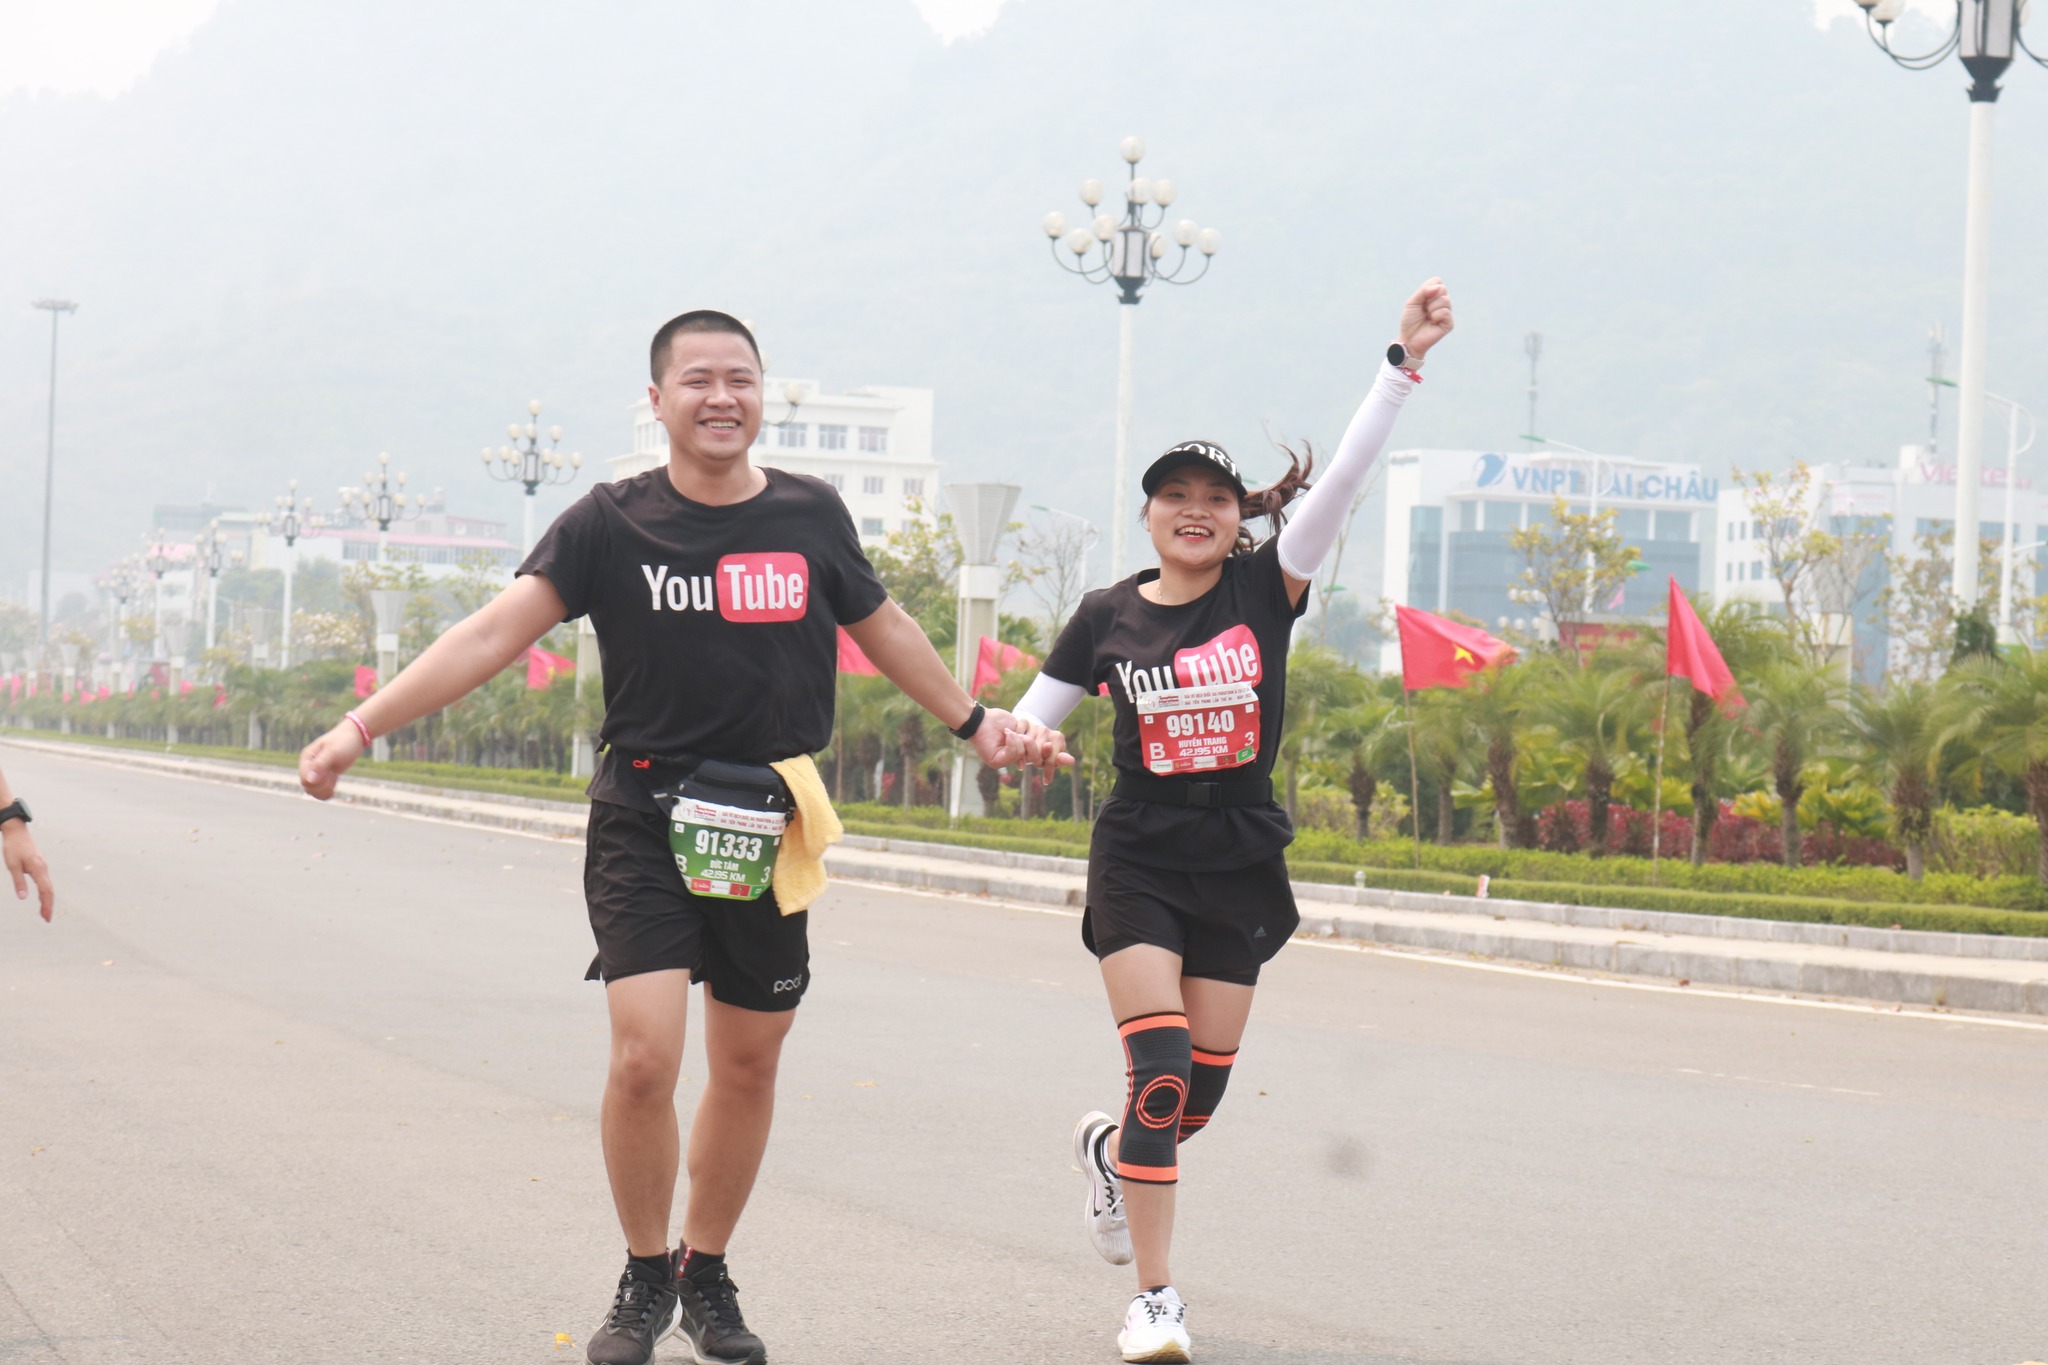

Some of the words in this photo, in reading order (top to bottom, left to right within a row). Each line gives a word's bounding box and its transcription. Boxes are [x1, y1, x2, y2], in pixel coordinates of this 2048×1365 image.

[1511, 467, 1582, 494] VNPT
[1598, 473, 1633, 497] AI
[1643, 470, 1720, 502] CHÂU
[641, 564, 714, 612] You
[723, 563, 804, 611] Tube
[1166, 709, 1235, 738] 99140
[1203, 736, 1227, 746] TRANG
[1244, 731, 1255, 747] 3
[1149, 742, 1166, 760] B
[1213, 745, 1228, 755] KM
[695, 829, 763, 862] 91333
[674, 853, 688, 873] B
[729, 872, 746, 882] KM
[760, 866, 771, 884] 3
